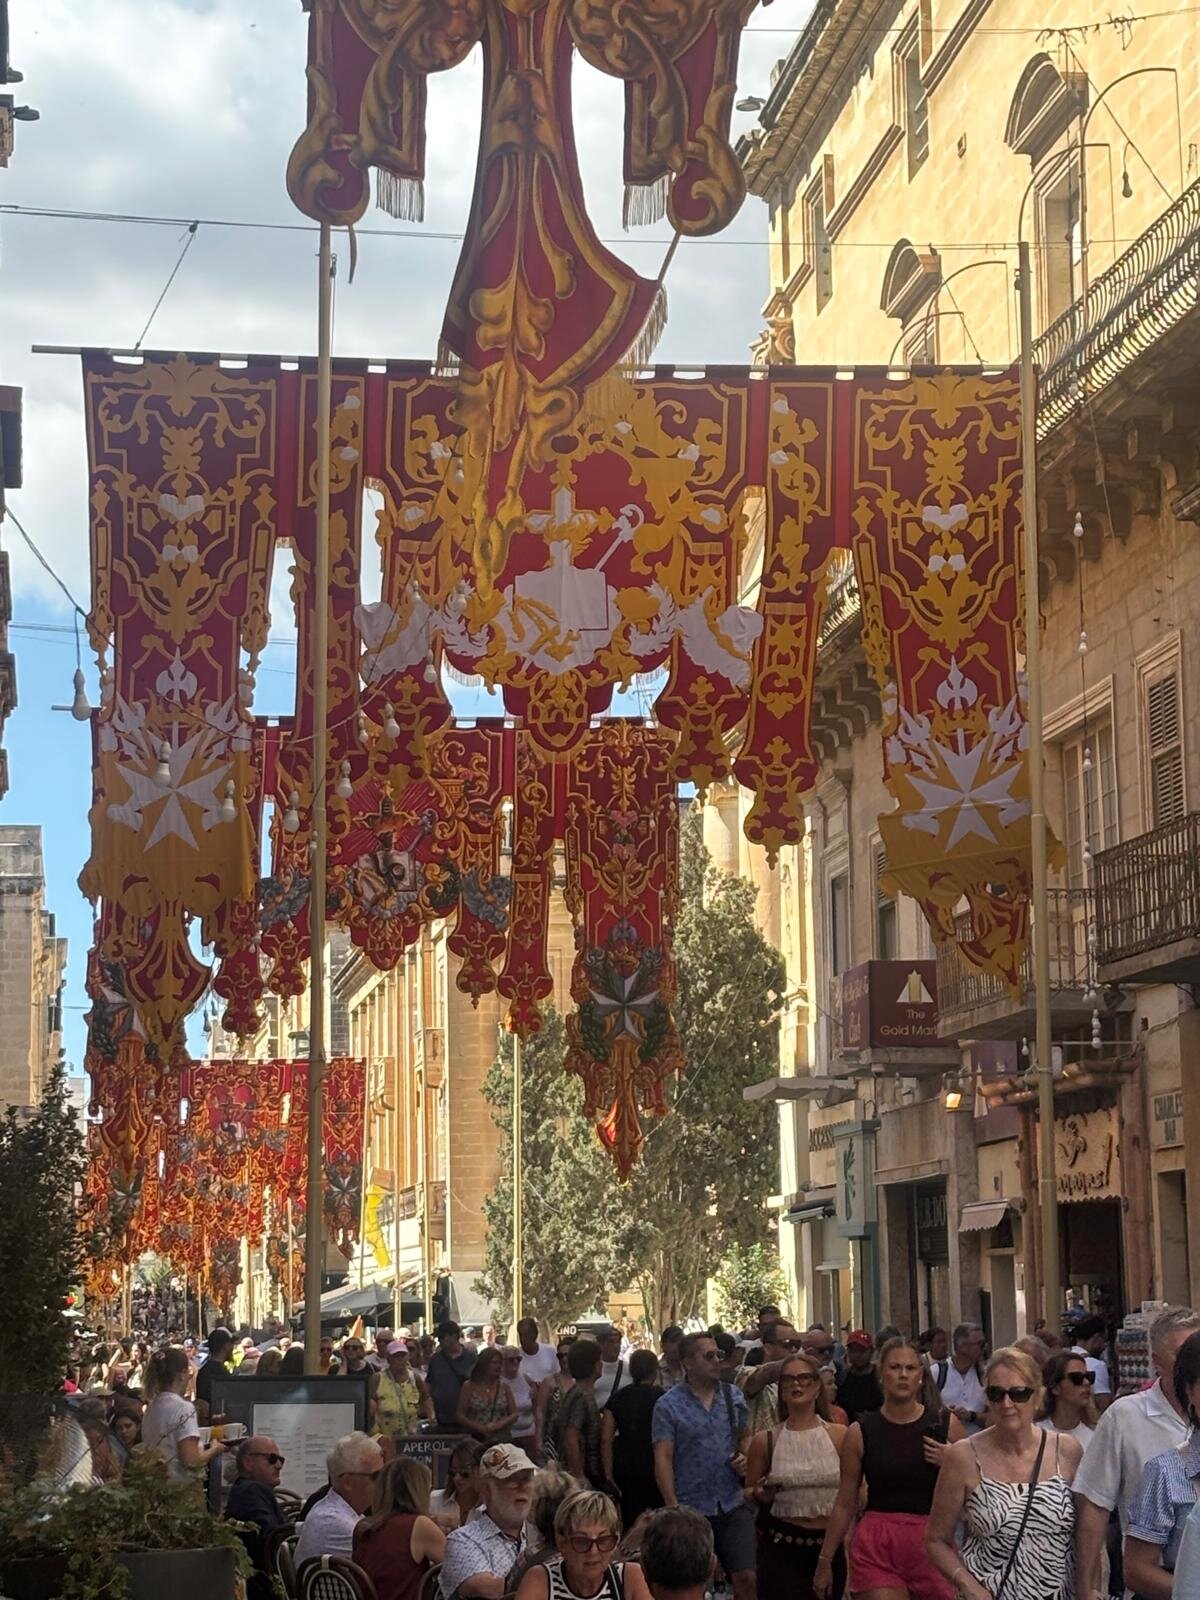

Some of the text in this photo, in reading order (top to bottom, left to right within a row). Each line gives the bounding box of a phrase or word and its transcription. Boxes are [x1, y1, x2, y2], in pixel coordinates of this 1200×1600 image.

[906, 1009, 926, 1019] The
[880, 1024, 909, 1036] Gold
[403, 1440, 447, 1453] APEROL
